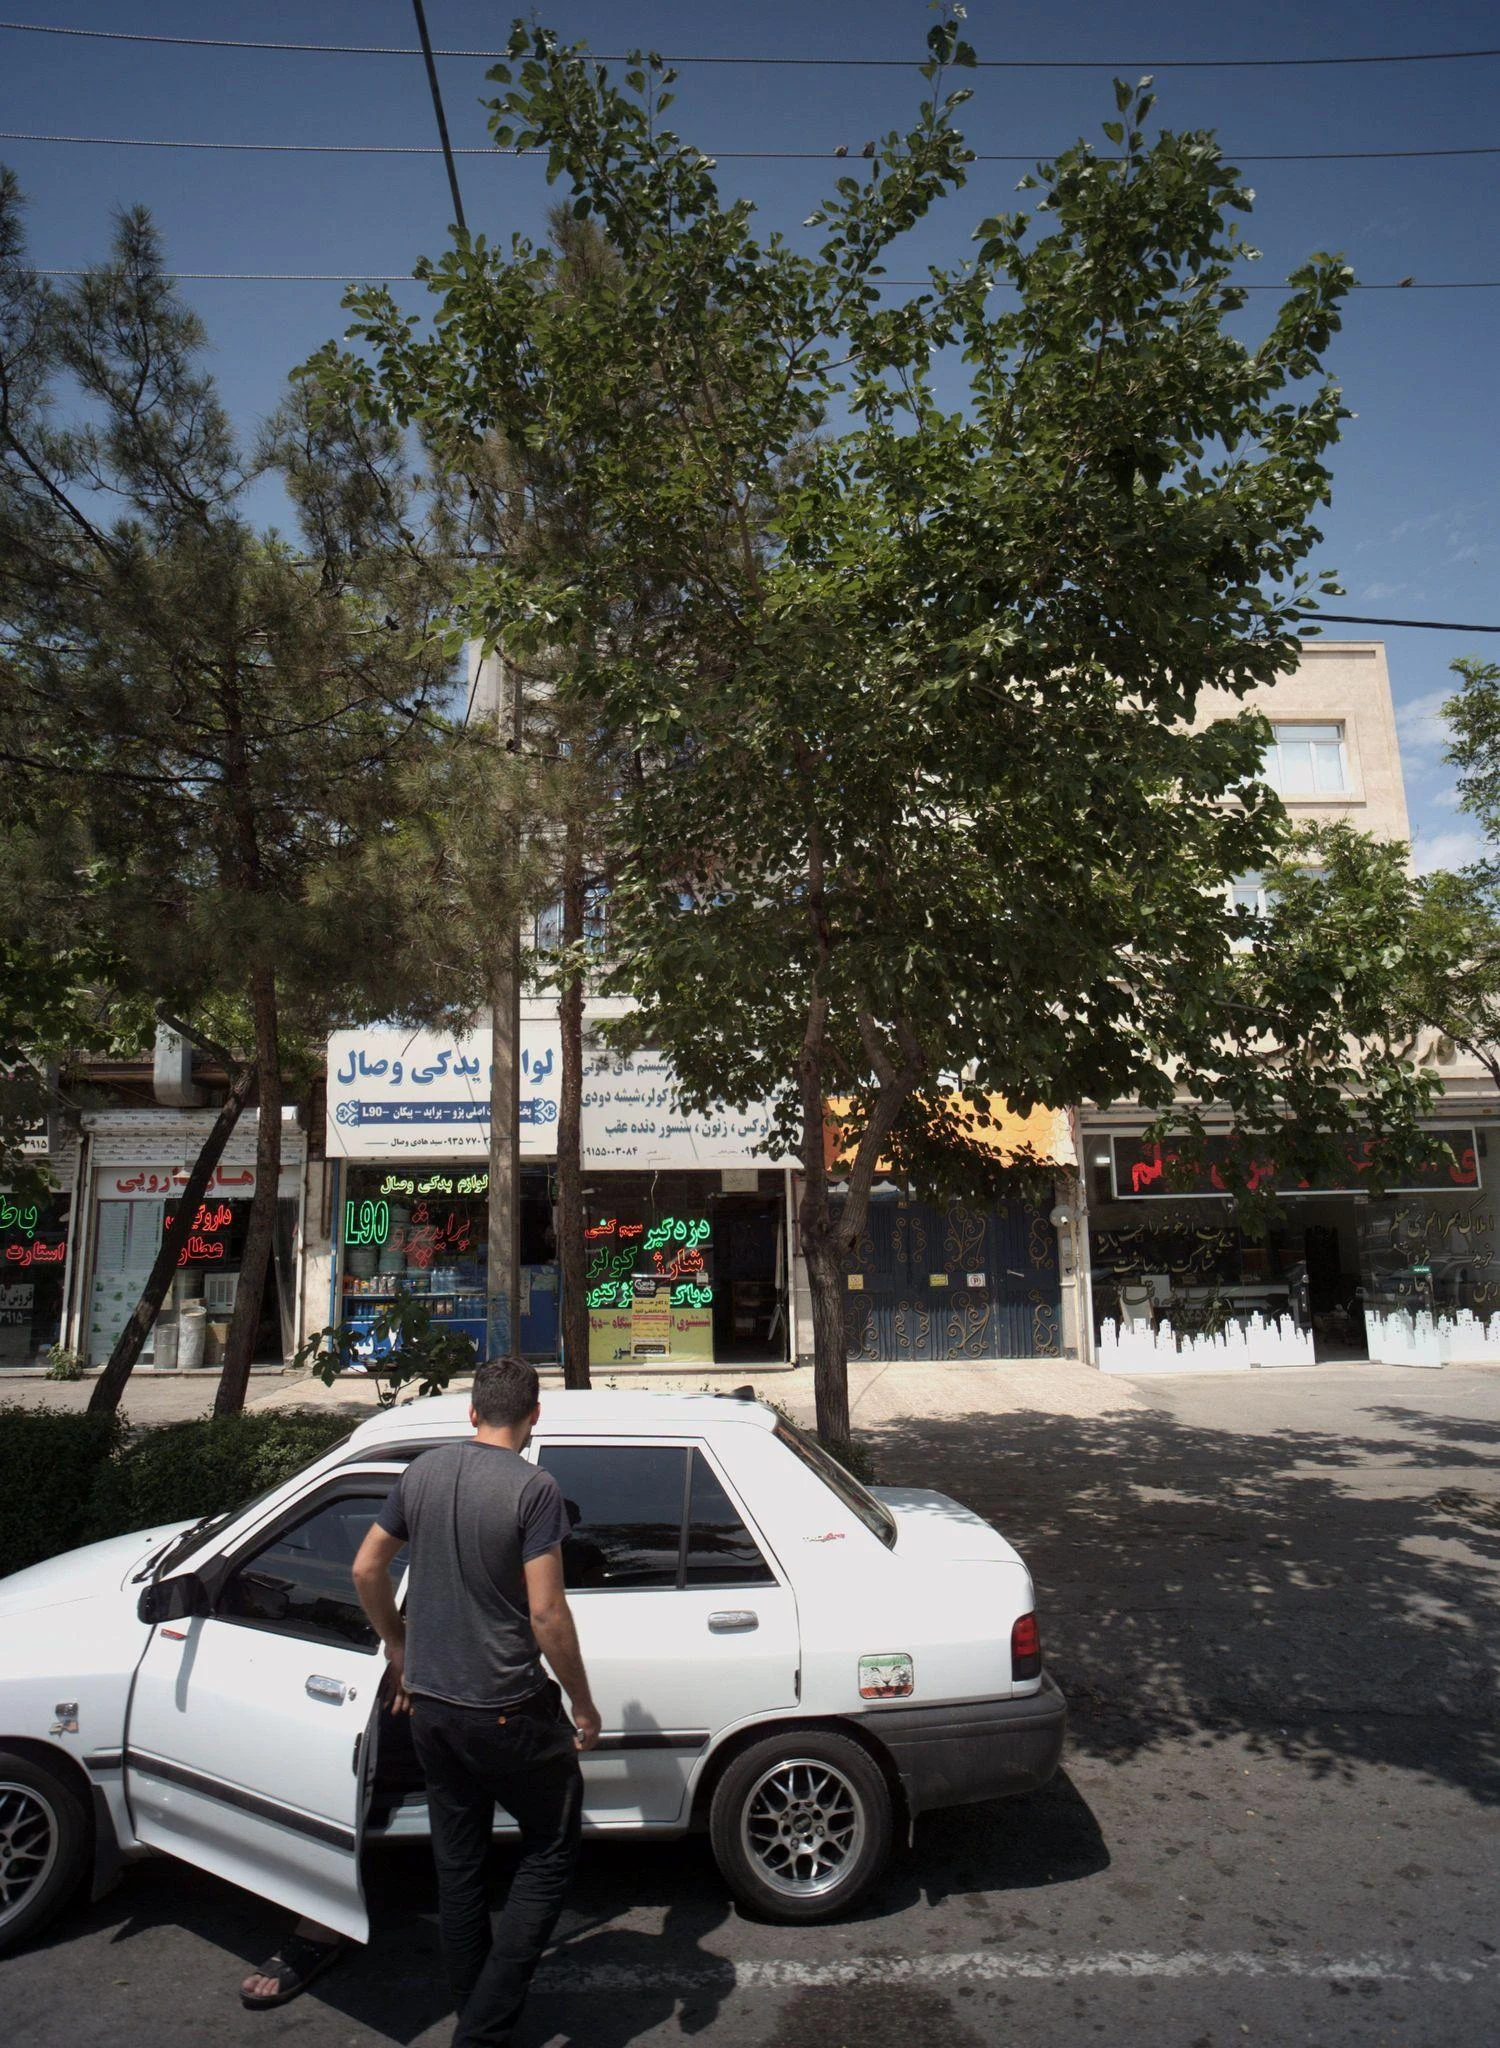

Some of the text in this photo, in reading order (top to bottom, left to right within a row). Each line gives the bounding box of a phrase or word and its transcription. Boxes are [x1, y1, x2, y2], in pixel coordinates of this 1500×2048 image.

[337, 1049, 403, 1085] وصال
[411, 1050, 480, 1084] یدکی
[613, 1059, 634, 1076] های
[605, 1118, 769, 1138] لوکس زنون سنسور دنده عقب
[380, 1173, 489, 1195] لوازم یدکی وصال
[345, 1200, 389, 1244] L90
[5, 1240, 65, 1266] استارت
[176, 1235, 224, 1266] عطار
[585, 1246, 638, 1279] کولر
